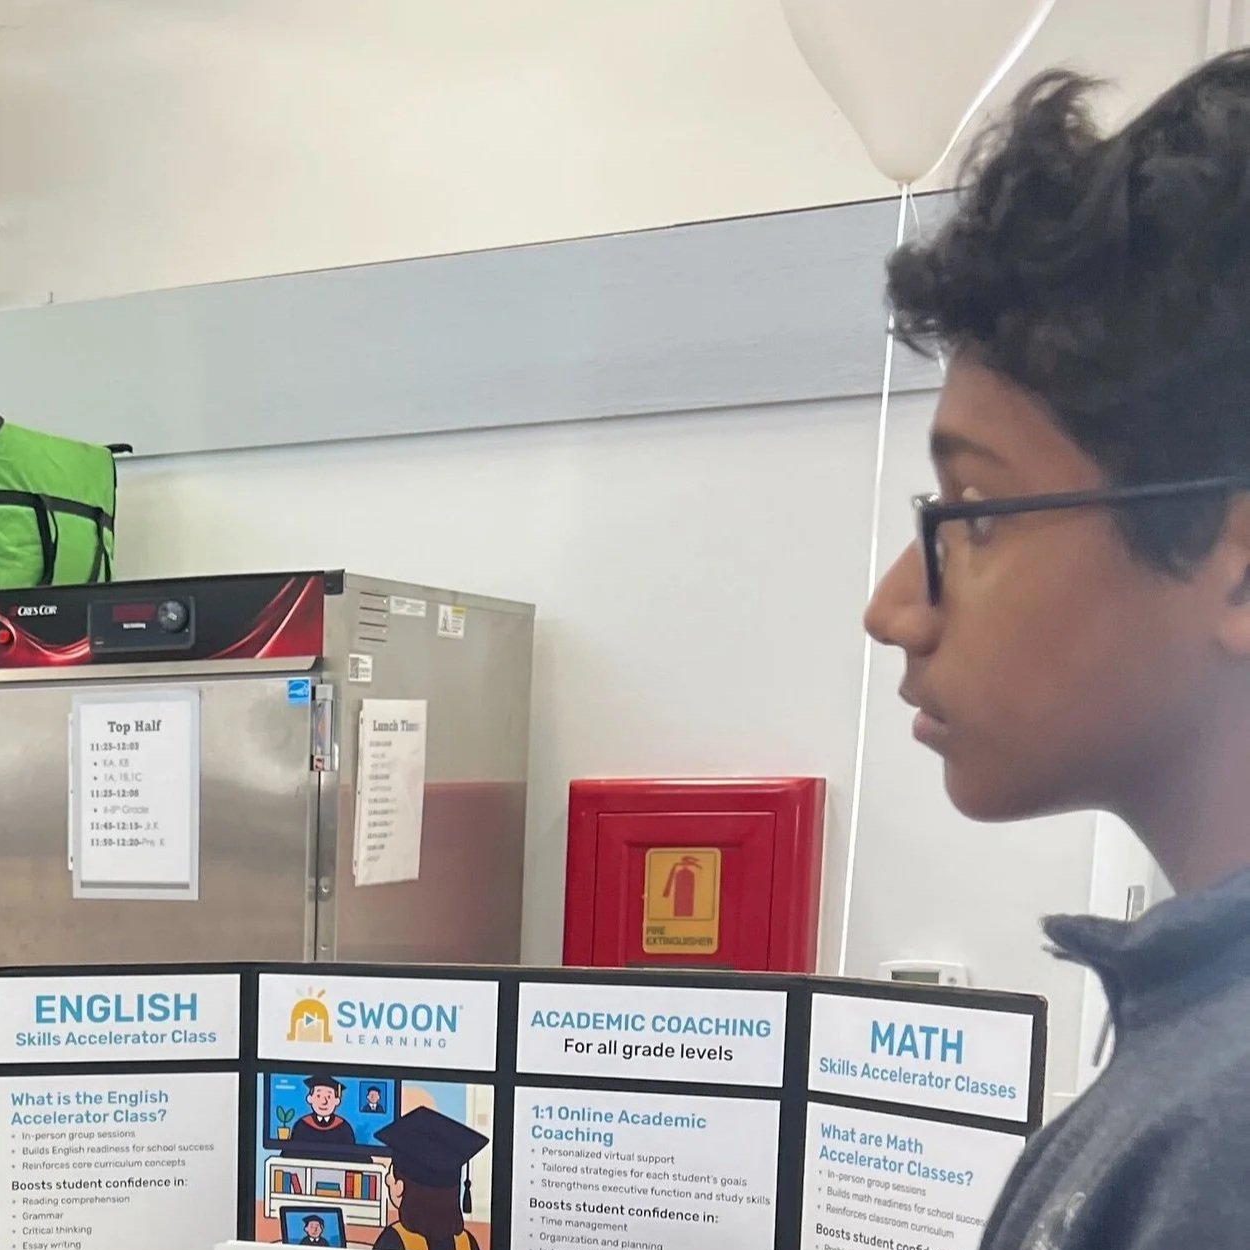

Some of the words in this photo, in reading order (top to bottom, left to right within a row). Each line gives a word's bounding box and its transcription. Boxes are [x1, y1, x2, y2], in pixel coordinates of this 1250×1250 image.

[108, 721, 130, 735] Top
[135, 720, 162, 732] Half
[373, 720, 398, 732] Lunch
[646, 936, 713, 947] EXTINGUISHER
[35, 992, 197, 1024] ENGLISH
[337, 1001, 457, 1033] SWOON
[531, 1010, 645, 1032] ACADEMIC
[651, 1015, 771, 1038] COACHING
[15, 1032, 61, 1046] Skills
[65, 1031, 166, 1045] Accelerator
[172, 1029, 217, 1043] Class
[346, 1034, 447, 1048] LEARNING
[870, 1020, 963, 1064] MATH
[564, 1038, 593, 1054] For
[597, 1040, 617, 1055] all
[622, 1042, 675, 1060] grade
[680, 1044, 733, 1061] levels
[819, 1057, 858, 1077] Skills
[861, 1062, 950, 1090] Accelerator
[955, 1075, 1016, 1099] Classes
[11, 1092, 53, 1106] What
[57, 1093, 71, 1105] is
[75, 1091, 103, 1104] the
[107, 1090, 169, 1107] English
[11, 1111, 109, 1125] Accelerator
[113, 1109, 167, 1123] Class?
[531, 1105, 553, 1120] 1:1
[558, 1106, 613, 1123] Online
[618, 1110, 706, 1129] Academic
[22, 1132, 66, 1141] In-person
[69, 1131, 95, 1140] group
[97, 1130, 135, 1138] sessions
[531, 1125, 614, 1147] Coaching
[820, 1123, 855, 1143] What
[859, 1133, 882, 1147] are
[886, 1133, 923, 1154] Math
[22, 1146, 49, 1155] Builds
[52, 1145, 85, 1155] English
[87, 1145, 130, 1153] readiness
[132, 1144, 144, 1152] for
[147, 1144, 176, 1152] school
[541, 1147, 602, 1160] Personalized
[604, 1151, 635, 1161] virtual
[637, 1153, 675, 1165] support
[22, 1161, 70, 1170] Reinforces
[72, 1161, 92, 1169] core
[94, 1160, 142, 1168] curriculum
[144, 1158, 185, 1168] concepts
[819, 1145, 904, 1174] Accelerator
[907, 1160, 974, 1186] Classes?
[11, 1180, 52, 1191] Boosts
[56, 1179, 102, 1190] student
[105, 1178, 171, 1189] confidence
[173, 1177, 188, 1187] in:
[541, 1163, 578, 1174] Tailored
[580, 1166, 627, 1178] strategies
[630, 1169, 644, 1178] for
[646, 1170, 670, 1181] each
[672, 1172, 718, 1184] student's
[720, 1176, 747, 1187] goals
[827, 1169, 865, 1185] In-person
[867, 1177, 890, 1190] group
[892, 1182, 926, 1196] sessions
[541, 1179, 599, 1192] Strengthens
[601, 1184, 648, 1195] executive
[650, 1188, 691, 1199] function
[694, 1190, 713, 1201] and
[715, 1193, 743, 1204] study
[746, 1195, 770, 1205] skills
[22, 1197, 59, 1207] Reading
[61, 1196, 130, 1205] comprehension
[827, 1186, 850, 1200] Builds
[852, 1192, 872, 1204] math
[874, 1197, 912, 1212] readiness
[914, 1203, 925, 1215] for
[927, 1205, 954, 1220] school
[955, 1214, 988, 1227] succes
[22, 1212, 64, 1220] Grammar
[529, 1198, 572, 1212] Boosts
[575, 1202, 625, 1216] student
[628, 1206, 700, 1222] confidence
[703, 1212, 719, 1224] in:
[540, 1216, 562, 1227] Time
[565, 1220, 627, 1231] management
[826, 1204, 867, 1220] Reinforces
[868, 1214, 908, 1229] classroom
[910, 1221, 954, 1238] curriculum
[22, 1226, 54, 1235] Critical
[56, 1226, 92, 1235] thinking
[539, 1232, 598, 1245] Organization
[601, 1238, 619, 1247] and
[816, 1223, 851, 1241] Boosts
[853, 1231, 894, 1250] student
[22, 1242, 48, 1250] Essay
[50, 1240, 81, 1249] writing
